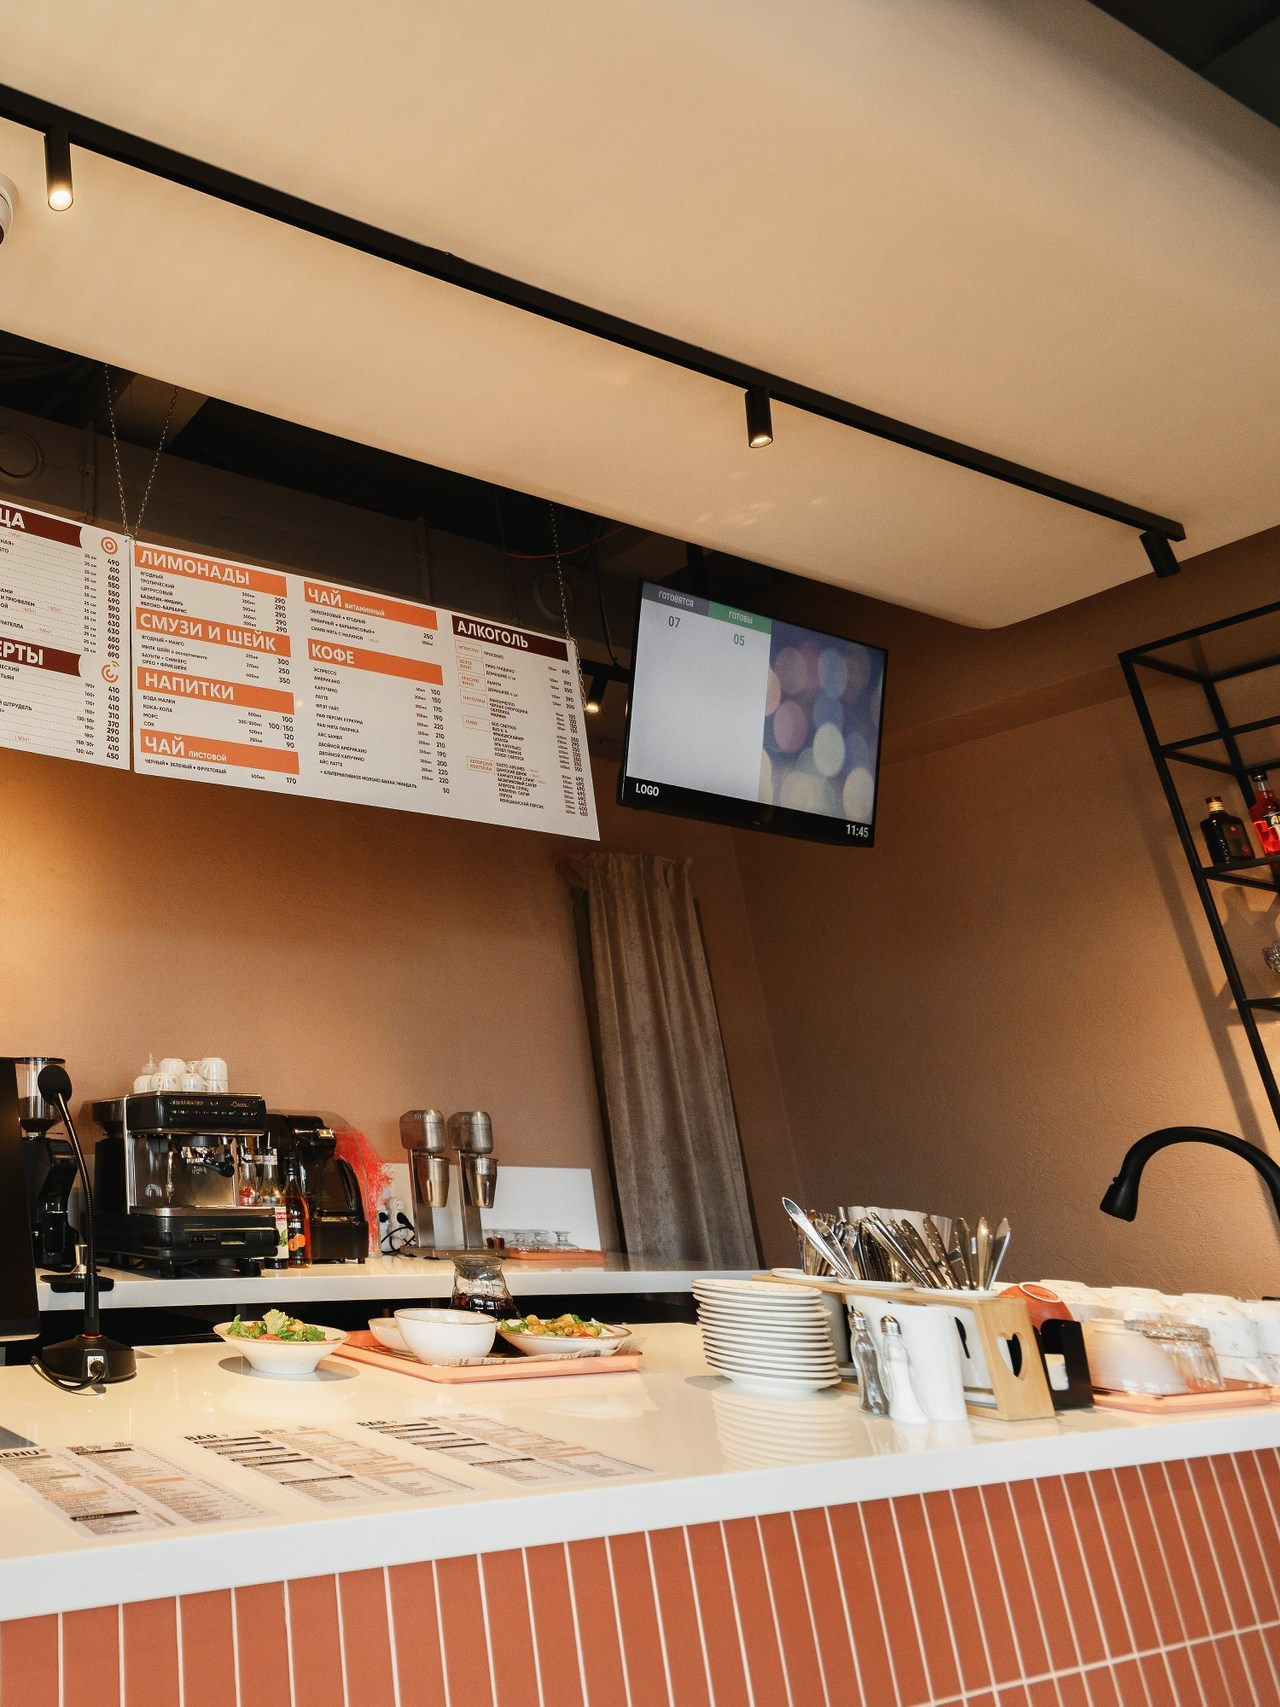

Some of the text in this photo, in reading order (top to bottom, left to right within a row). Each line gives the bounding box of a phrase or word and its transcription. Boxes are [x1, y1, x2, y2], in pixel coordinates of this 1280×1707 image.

[139, 549, 250, 586] ЛИМОНАДЫ
[107, 596, 121, 606] 490
[274, 596, 286, 605] 290
[308, 587, 342, 608] ЧАЙ
[658, 590, 694, 608] ГОТОВЯТСЯ
[668, 615, 681, 629] 07
[728, 610, 753, 625] ГОТОВЫ
[140, 612, 277, 652] СМУЗИ И ШЕЙК
[423, 632, 434, 641] 250
[457, 620, 528, 649] АЛКОГОЛЬ
[733, 633, 745, 646] 05
[311, 643, 355, 665] КОФЕ
[277, 657, 290, 666] 300
[278, 667, 291, 675] 250
[278, 676, 291, 685] 350
[145, 671, 234, 701] НАПИТКИ
[431, 696, 442, 704] 150
[107, 703, 120, 712] 410
[281, 715, 294, 724] 100
[106, 734, 120, 744] 200
[283, 733, 295, 741] 120
[144, 735, 227, 762] ЧАЙ ЛИСТОВОЙ
[285, 741, 295, 749] 90
[285, 776, 297, 785] 170
[635, 782, 660, 797] LOGO
[846, 823, 869, 838] 11:45
[184, 1433, 218, 1442] BAR
